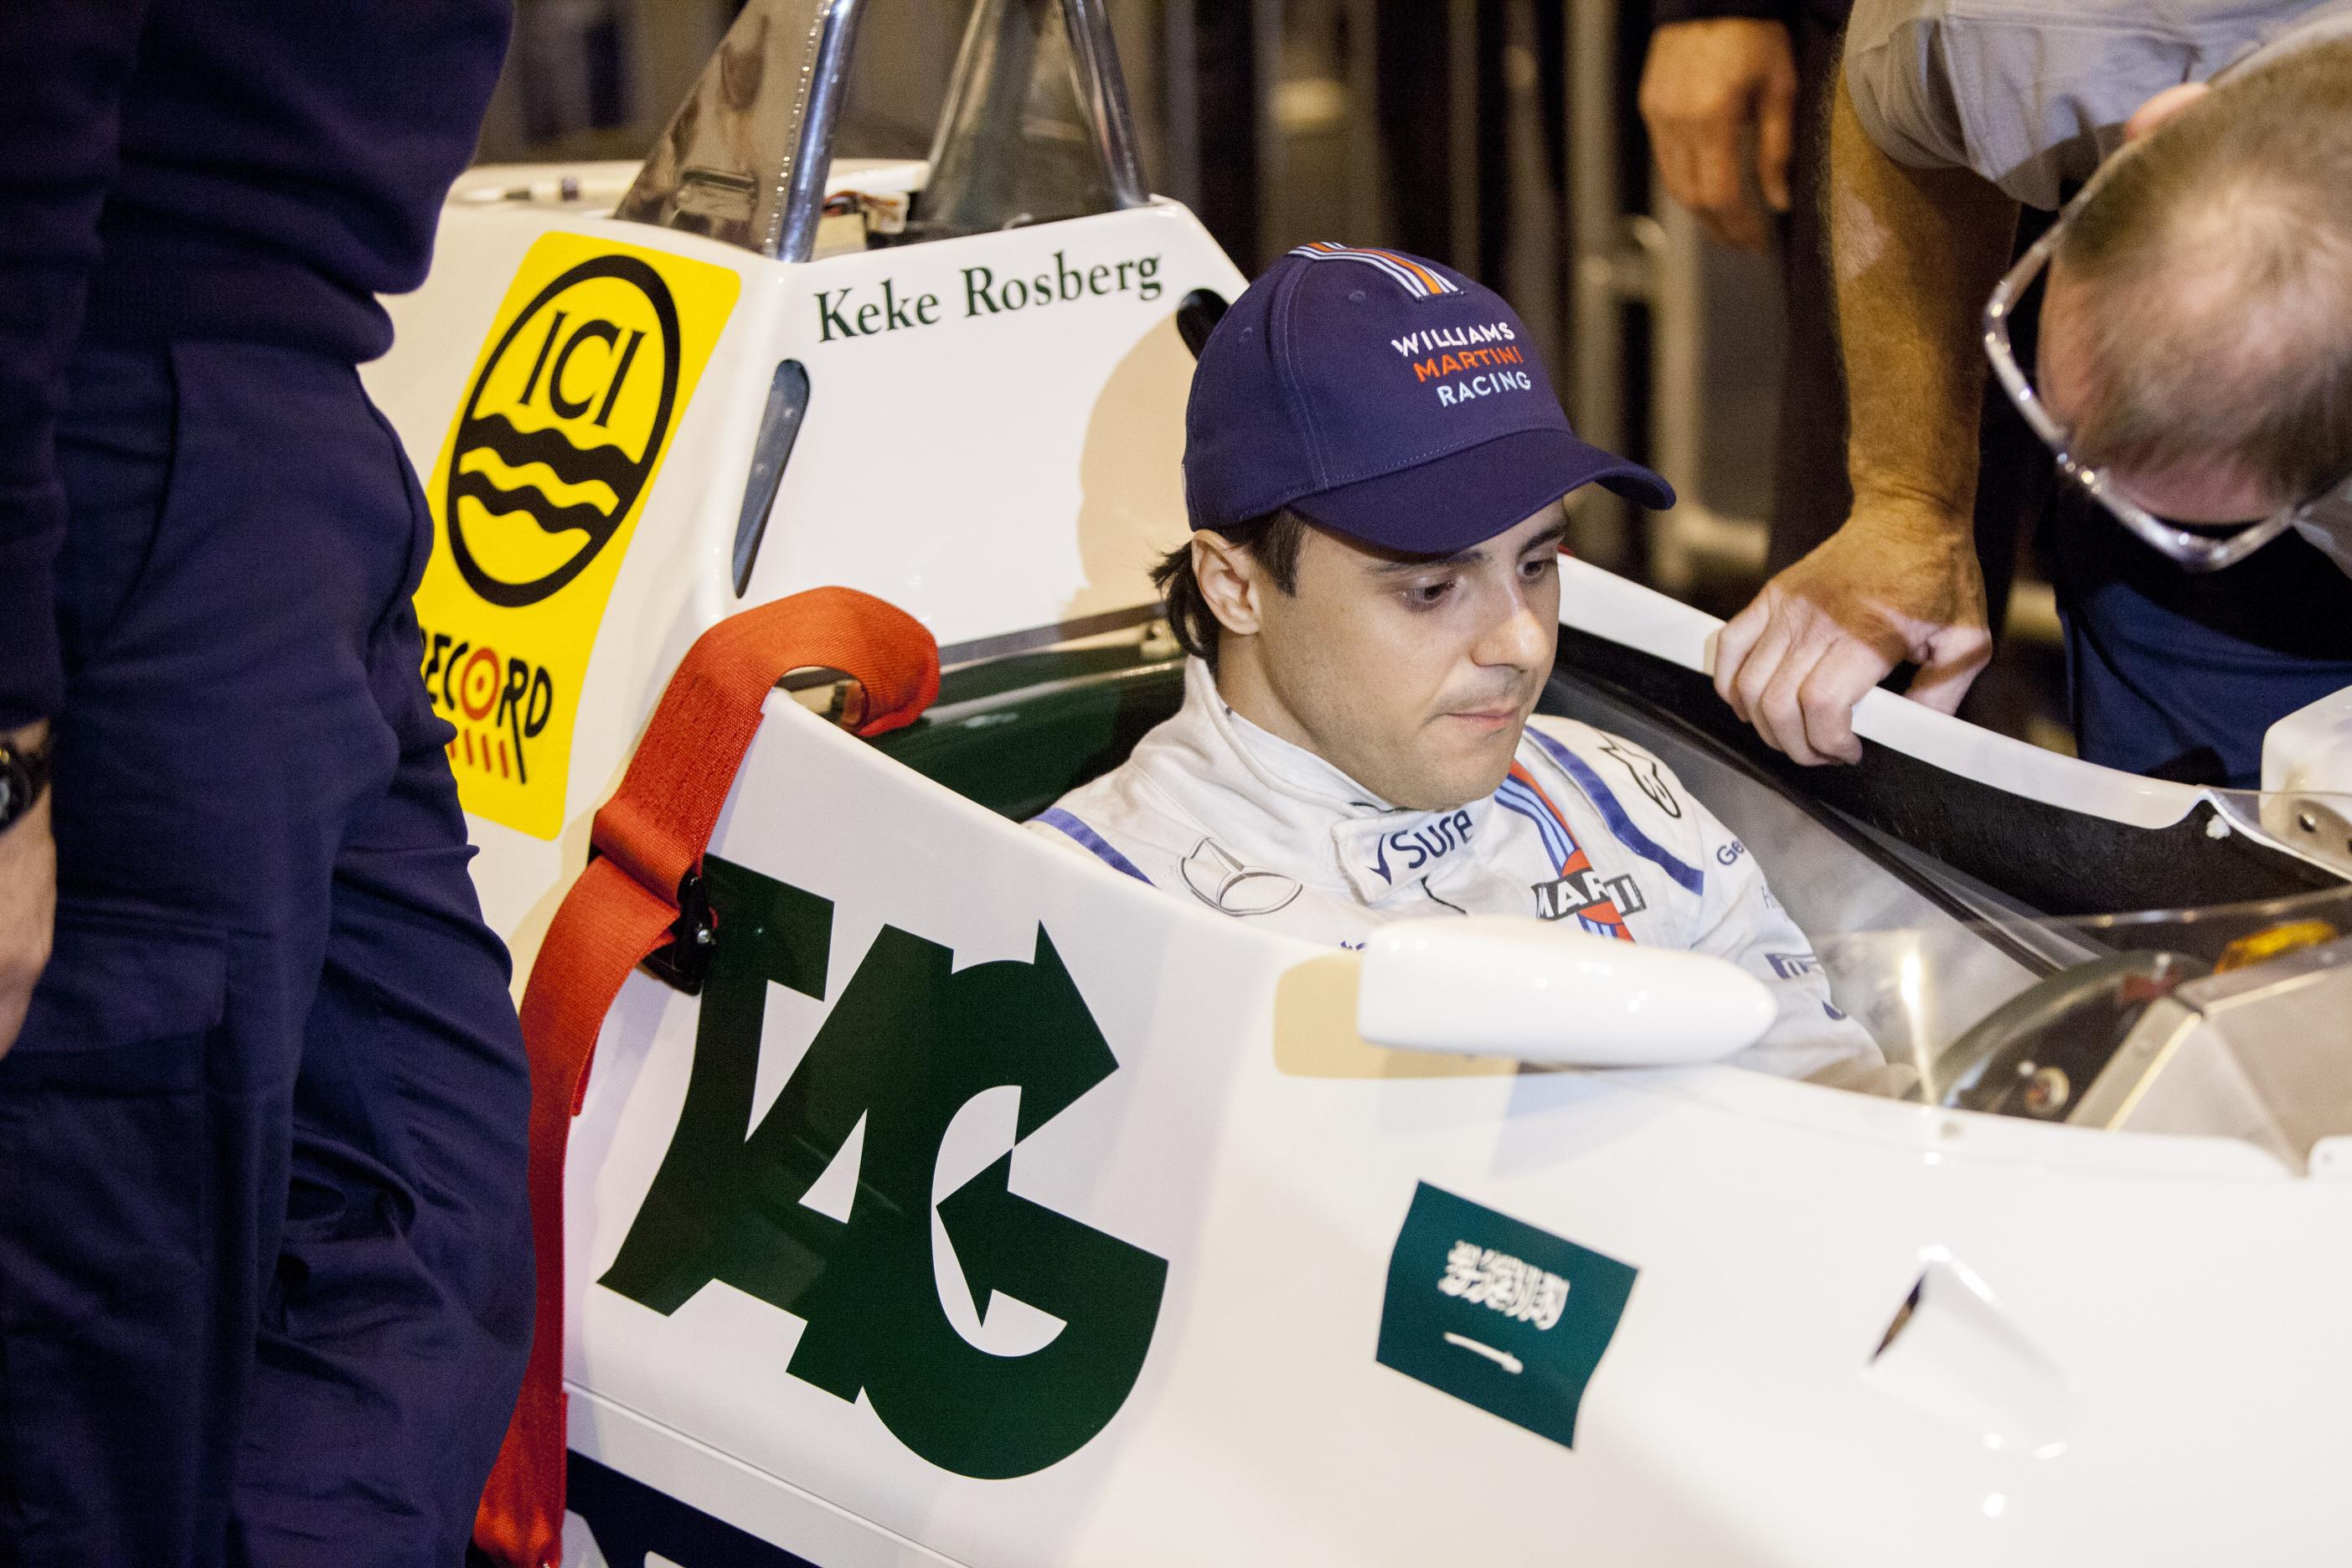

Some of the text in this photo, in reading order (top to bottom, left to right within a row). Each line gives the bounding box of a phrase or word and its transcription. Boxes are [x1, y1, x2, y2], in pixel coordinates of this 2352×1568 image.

[813, 250, 1163, 343] Keke Rosberg
[517, 310, 647, 428] ICI
[1390, 322, 1515, 358] WILLIAMS
[1413, 346, 1524, 383] MARTINI
[1436, 371, 1531, 408] RACING
[419, 627, 552, 785] ECORD
[1390, 809, 1474, 869] Sure
[596, 852, 1169, 1481] TAG
